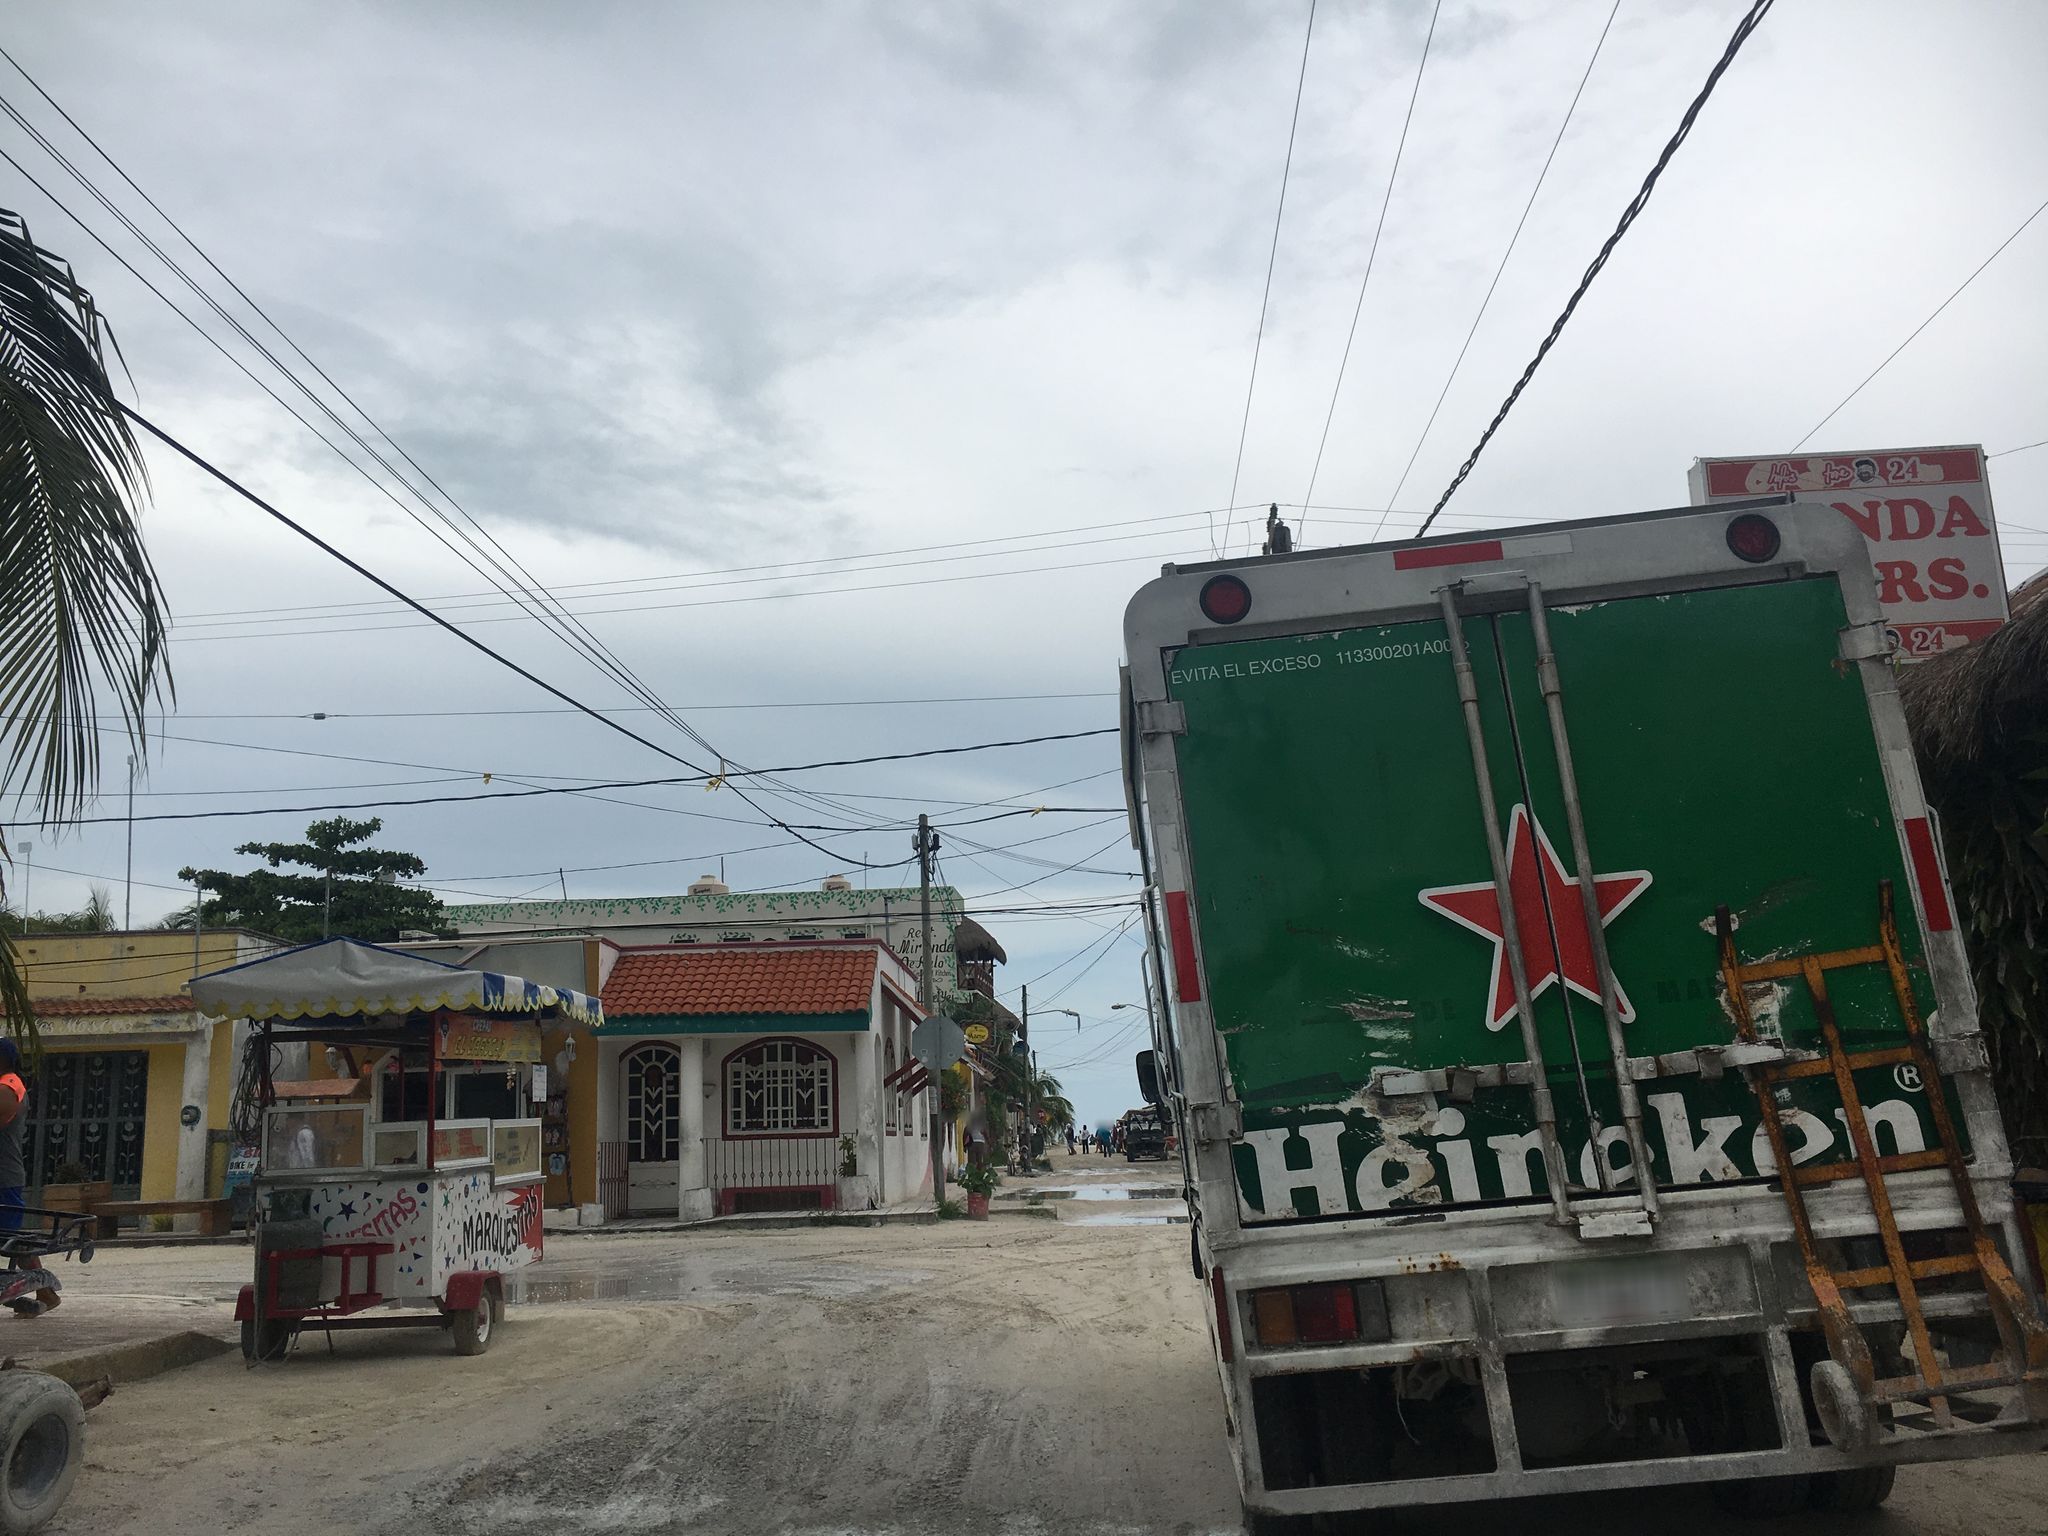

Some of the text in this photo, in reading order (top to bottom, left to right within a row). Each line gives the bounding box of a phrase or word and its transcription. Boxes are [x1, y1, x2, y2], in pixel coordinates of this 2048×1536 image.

[1171, 665, 1220, 685] EVITA
[1223, 662, 1246, 679] EL
[1249, 653, 1322, 676] EXCESO
[897, 939, 955, 954] Mirnda
[904, 926, 937, 939] Ret.
[1242, 1090, 1926, 1215] Heineken
[463, 1185, 539, 1261] MARQUESITAS
